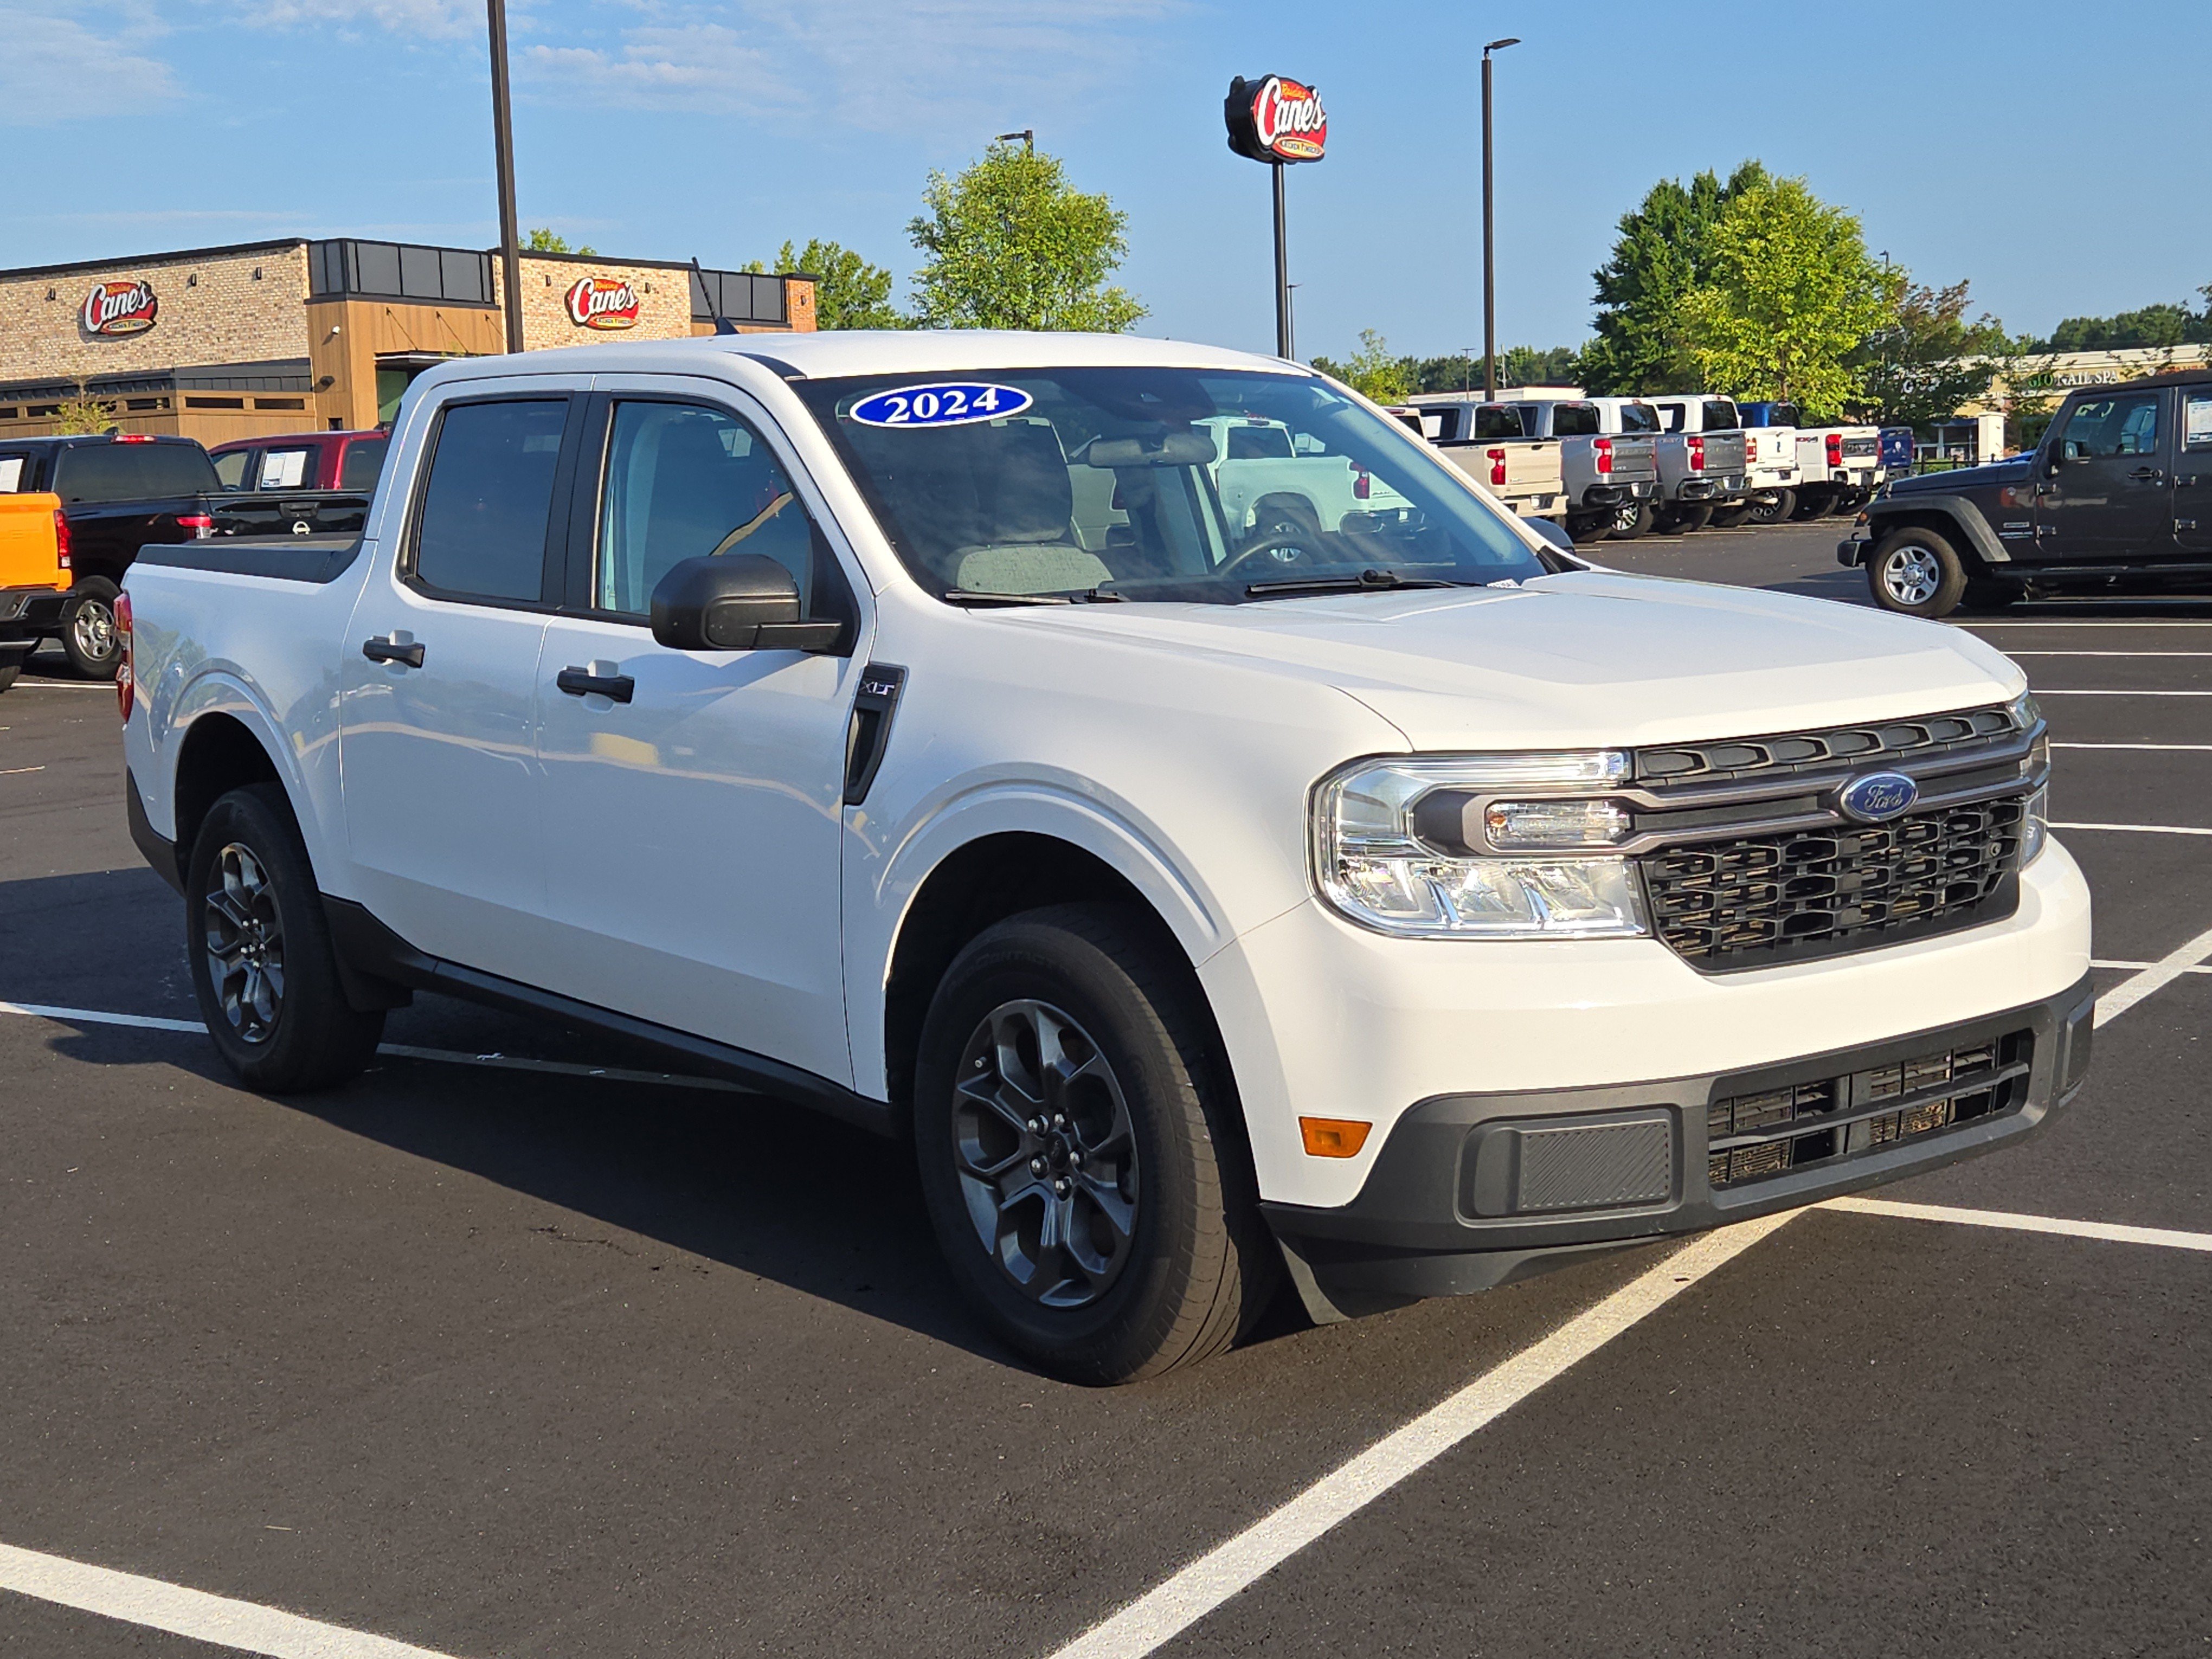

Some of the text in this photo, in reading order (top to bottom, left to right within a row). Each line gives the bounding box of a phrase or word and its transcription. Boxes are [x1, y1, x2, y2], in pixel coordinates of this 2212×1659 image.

[1257, 77, 1327, 146] Cane's
[85, 280, 153, 332] Cane's
[571, 277, 638, 323] Cane's
[2055, 371, 2092, 386] NAIL
[2094, 370, 2119, 385] SPA
[884, 387, 999, 423] 2024
[859, 680, 895, 696] XLT
[1864, 784, 1904, 812] Ford
